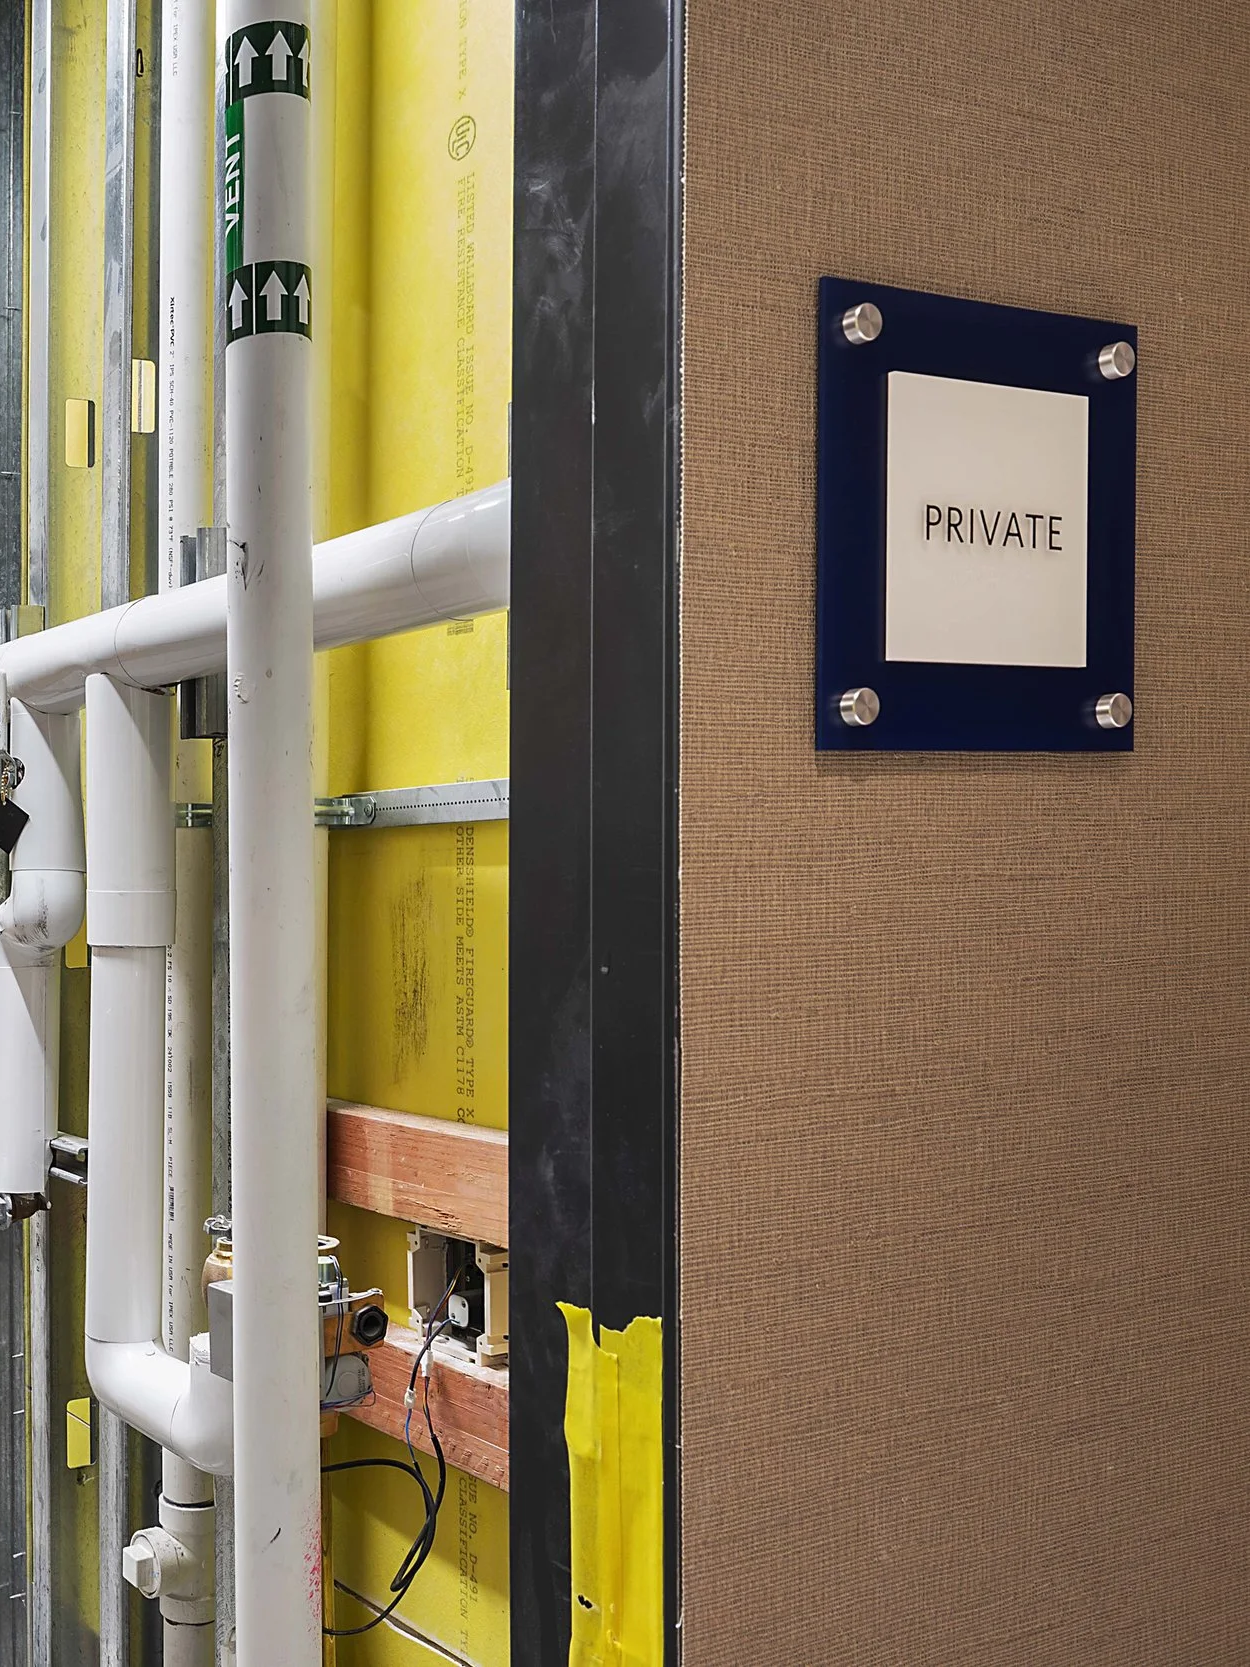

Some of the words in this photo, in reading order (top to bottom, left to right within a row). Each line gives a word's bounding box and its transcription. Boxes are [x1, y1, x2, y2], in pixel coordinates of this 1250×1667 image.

[225, 134, 240, 238] VENT
[457, 179, 466, 220] FIRE
[466, 172, 475, 237] LISTED
[457, 228, 466, 329] RESISTANCE
[465, 245, 475, 335] WALLBOARD
[465, 346, 474, 396] ISSUE
[465, 403, 474, 434] NO.
[926, 504, 1062, 551] PRIVATE
[456, 826, 464, 878] OTHER
[456, 886, 464, 926] SIDE
[456, 936, 464, 986] MEETS
[456, 995, 464, 1036] ASTM
[456, 1045, 464, 1095] C1178
[466, 1058, 474, 1098] TYPE
[466, 1107, 474, 1118] X
[459, 1477, 468, 1618] CLASSIFICATION
[468, 1513, 477, 1540] NO.
[468, 1553, 477, 1603] D-491
